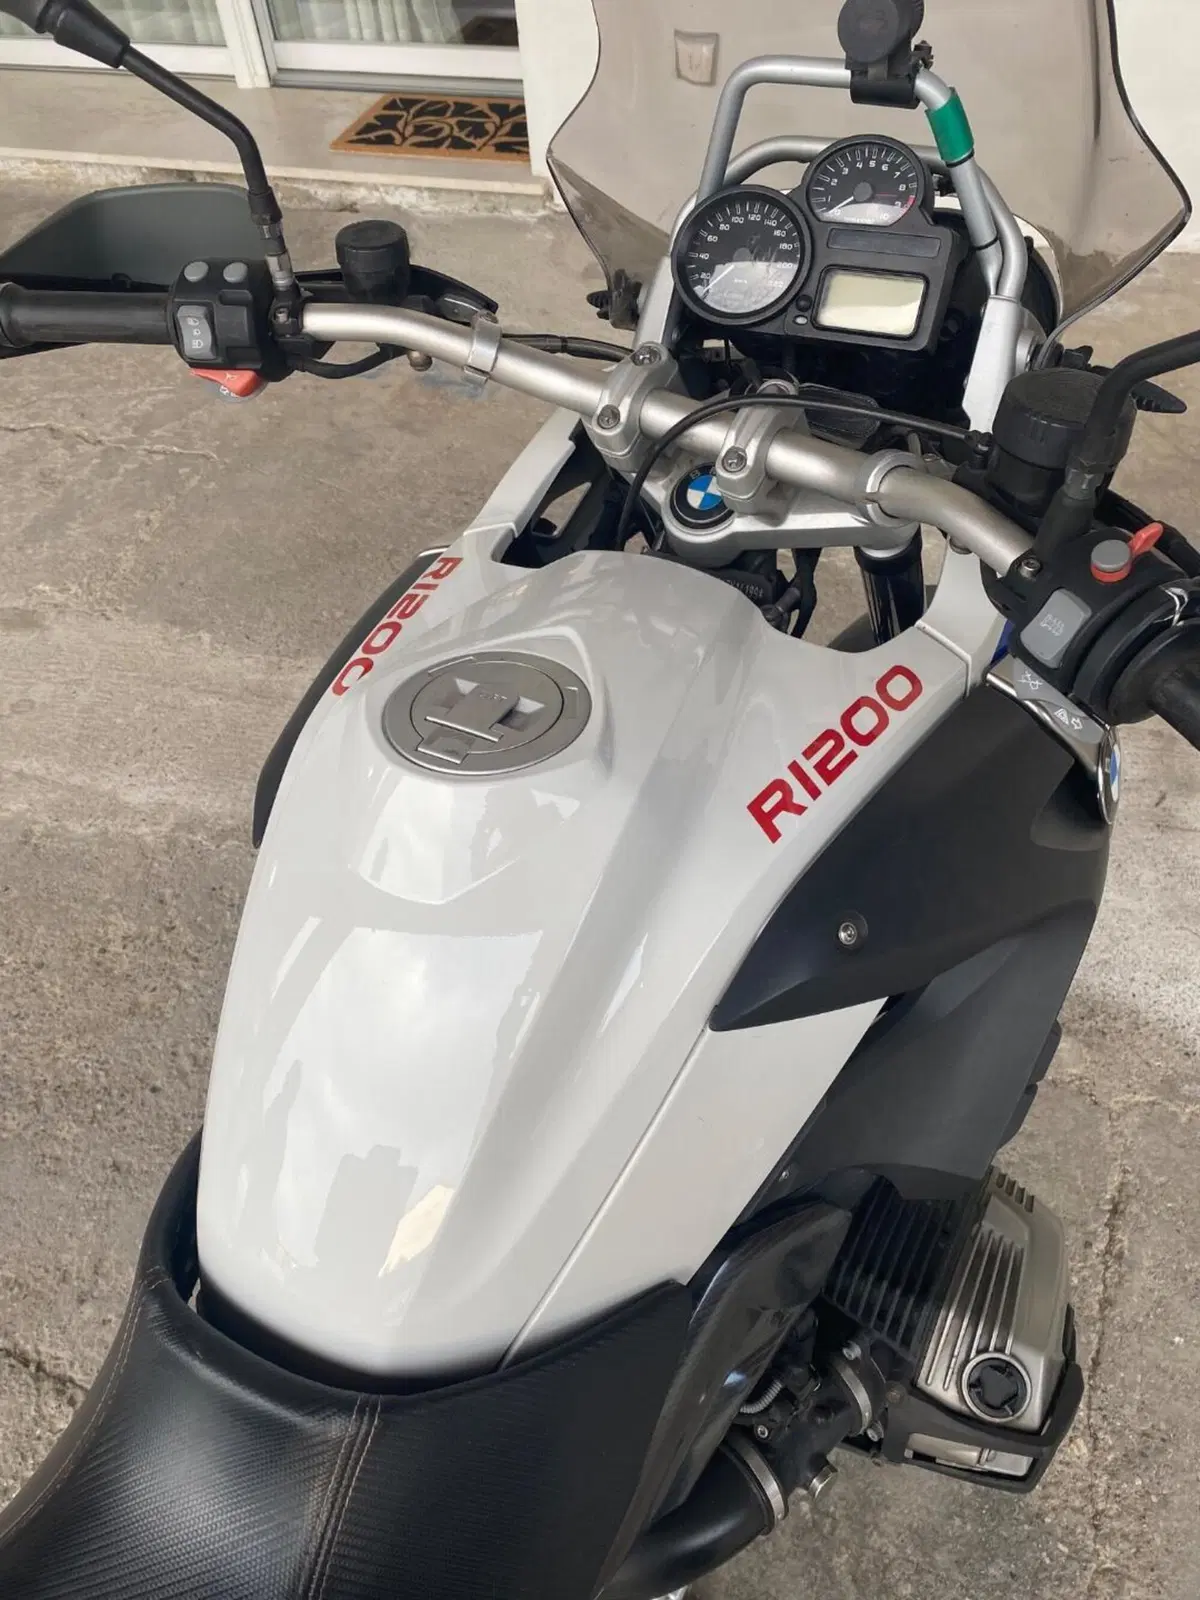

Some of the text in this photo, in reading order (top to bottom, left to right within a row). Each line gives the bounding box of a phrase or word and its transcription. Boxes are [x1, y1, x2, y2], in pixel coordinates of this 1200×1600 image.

[869, 160, 876, 168] 5
[842, 167, 849, 175] 3
[764, 219, 777, 227] 140
[746, 664, 923, 844] R1200
